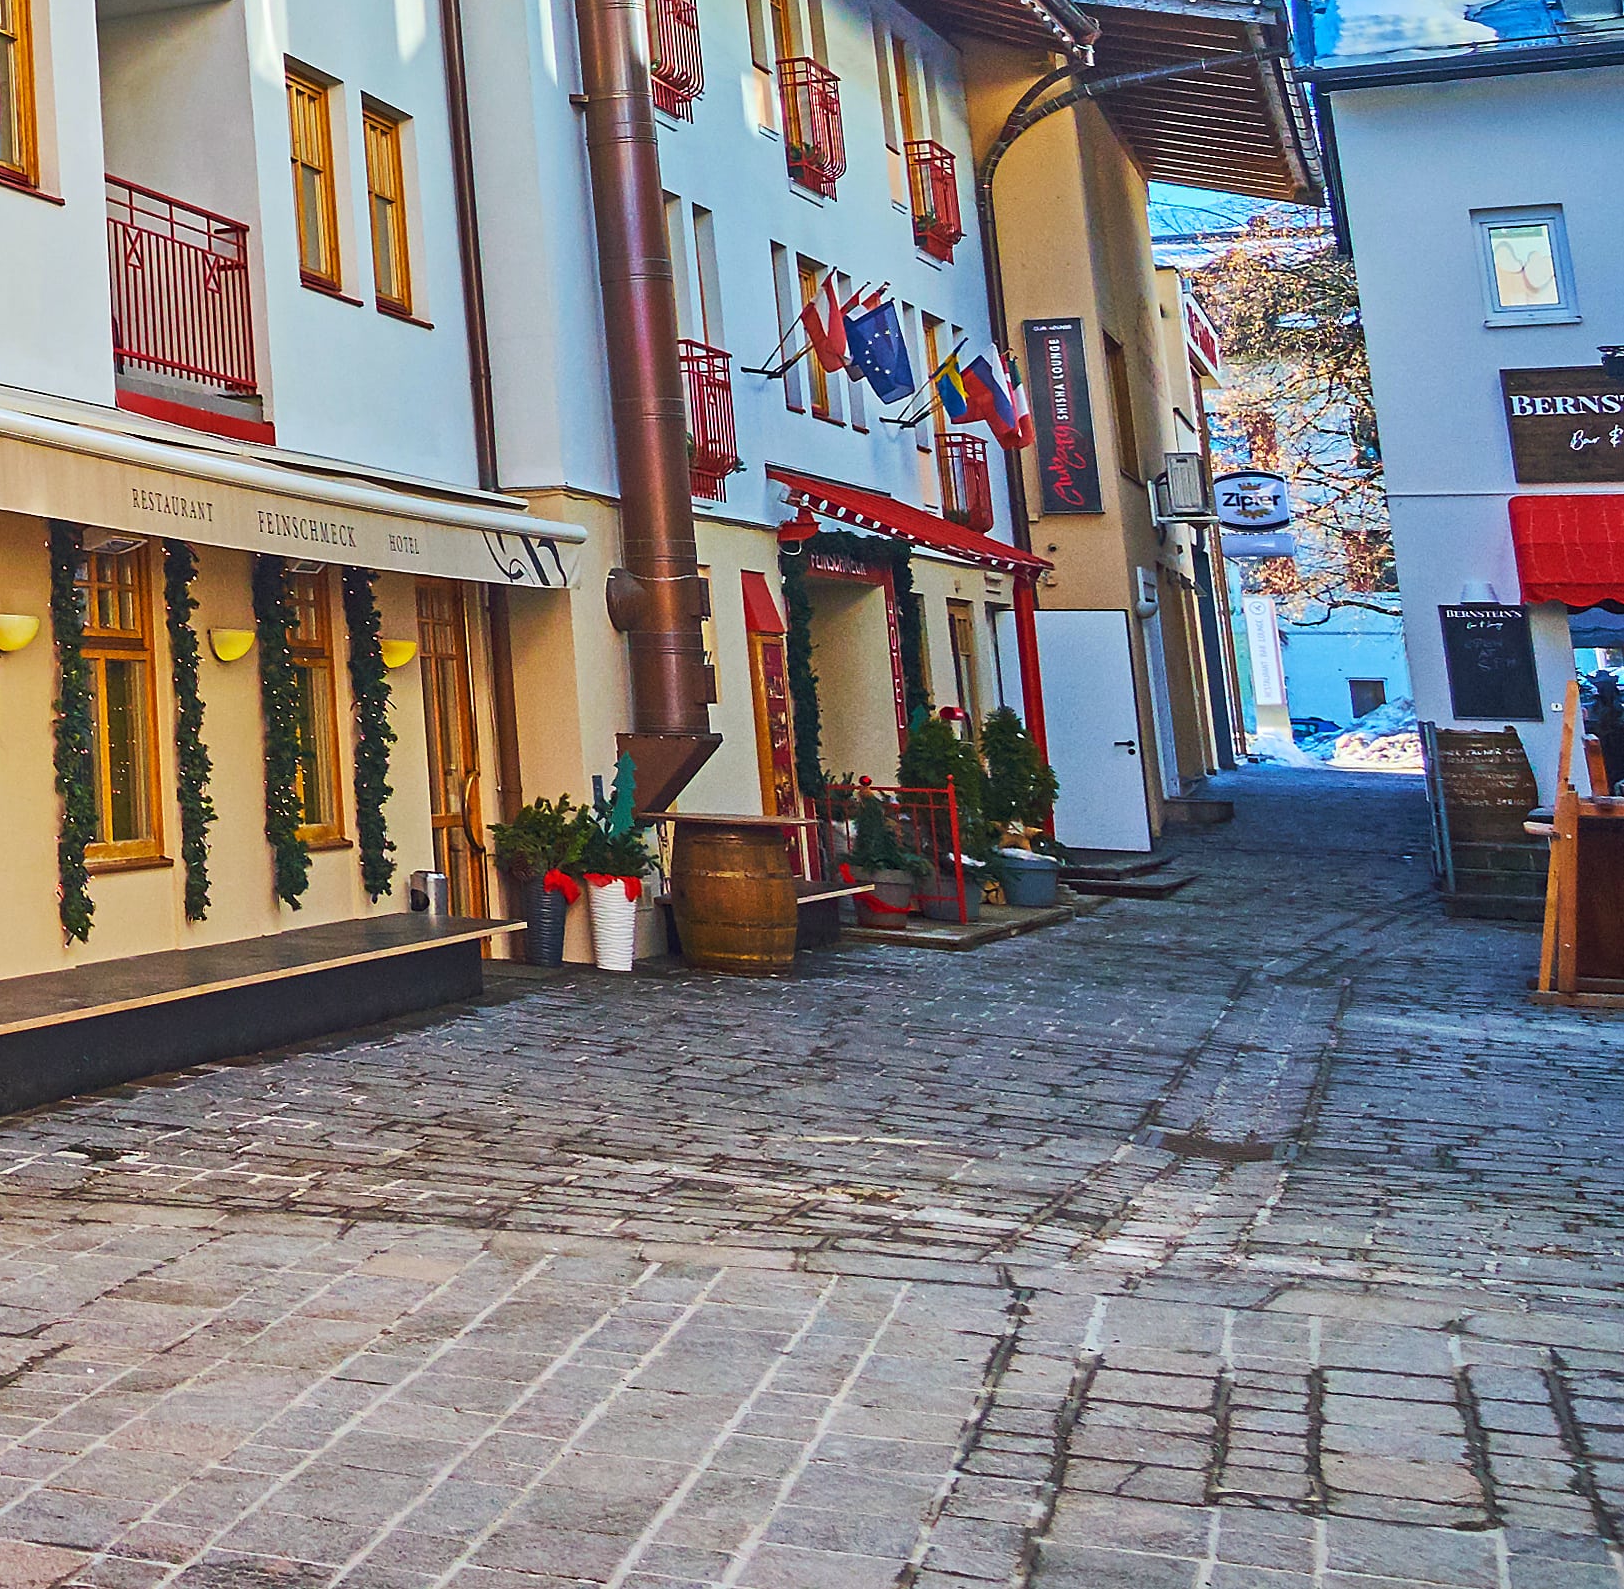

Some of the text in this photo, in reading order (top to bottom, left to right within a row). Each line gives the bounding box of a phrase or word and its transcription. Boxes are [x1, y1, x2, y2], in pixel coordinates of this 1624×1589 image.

[1048, 339, 1069, 421] SHISHA LOUNGE
[1509, 394, 1624, 416] BERNS
[1569, 429, 1601, 451] Bar
[131, 488, 420, 554] RESTAURANT FEINSCHMECK HOTEL
